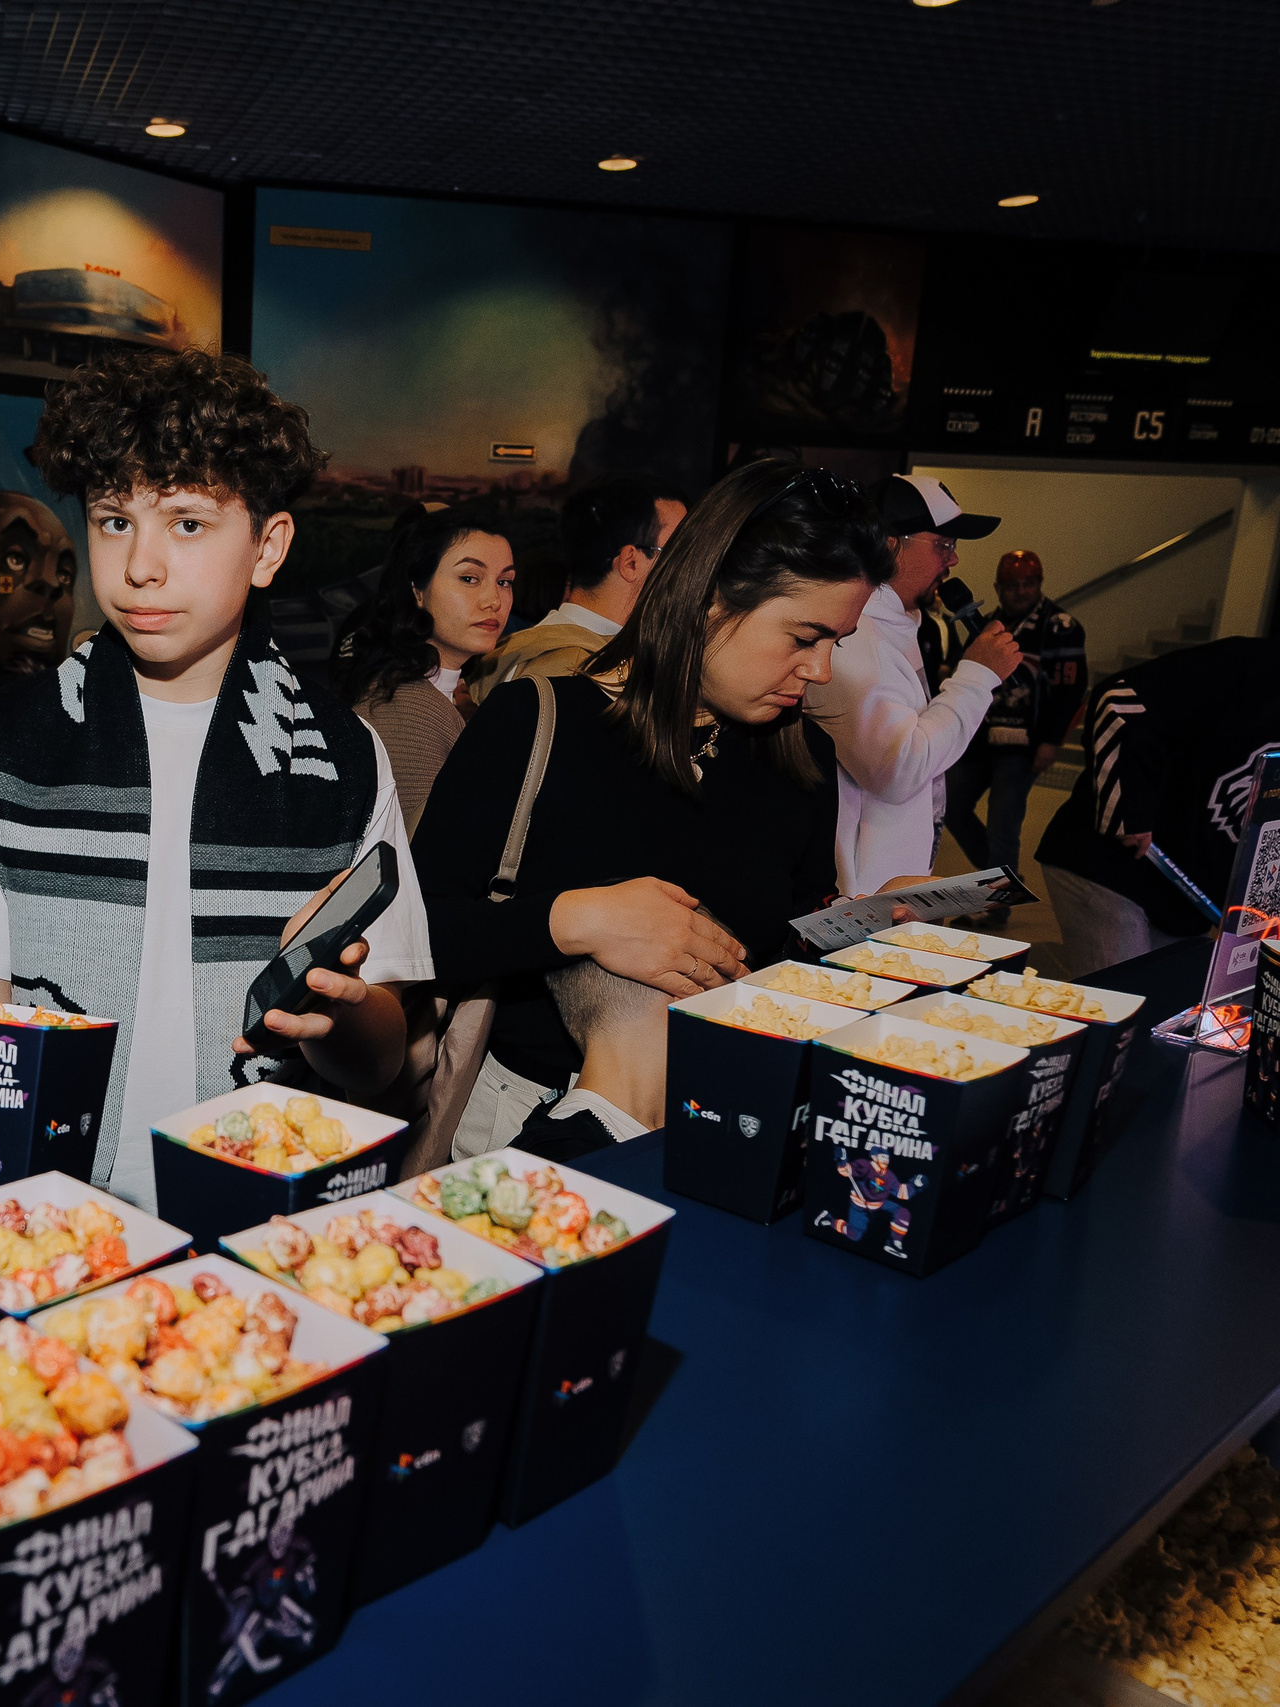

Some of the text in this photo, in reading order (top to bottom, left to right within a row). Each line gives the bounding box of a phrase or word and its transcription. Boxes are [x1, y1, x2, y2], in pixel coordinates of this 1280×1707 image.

[829, 1069, 926, 1117] ФИНАЛ
[843, 1095, 928, 1138] КУБКА
[814, 1114, 933, 1162] ГАГАРИНА
[316, 1162, 388, 1201] ФИНАЛ
[229, 1395, 352, 1460] ФИНАЛ
[247, 1432, 348, 1506] КУБКА
[201, 1454, 355, 1574] ГАГАРИНА
[20, 1540, 154, 1628] КУБКА
